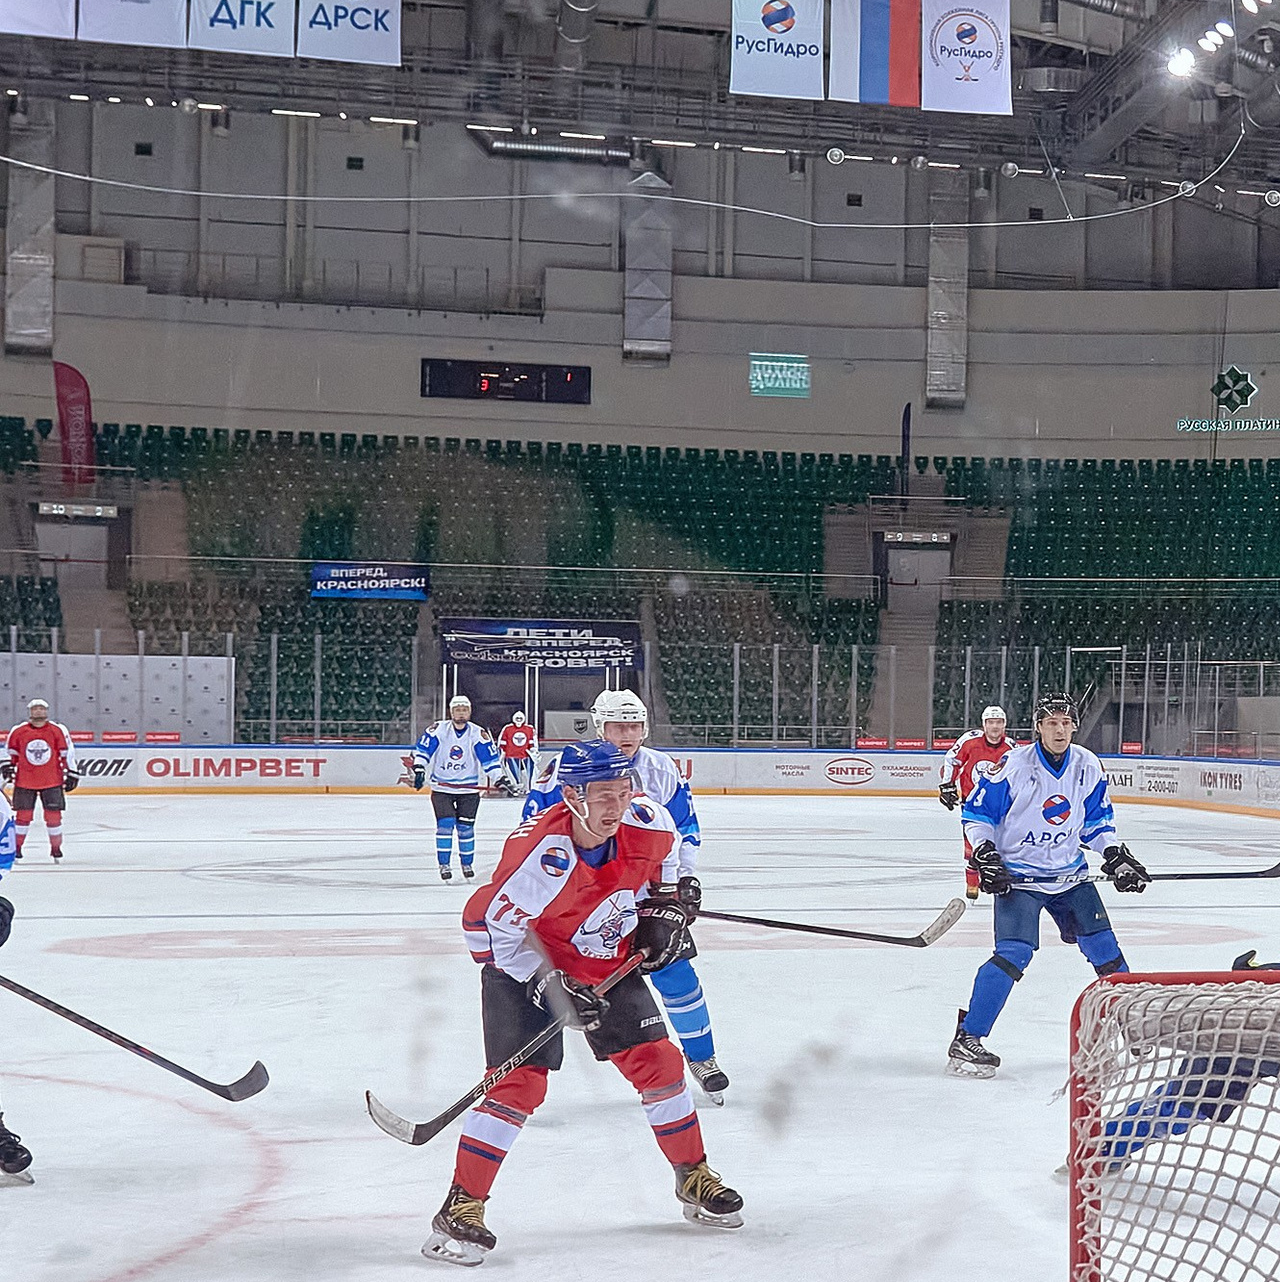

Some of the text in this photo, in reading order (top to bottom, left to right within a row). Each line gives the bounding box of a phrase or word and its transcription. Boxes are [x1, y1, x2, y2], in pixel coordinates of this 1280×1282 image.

[309, 3, 390, 32] ДРСК
[735, 34, 819, 58] РусГидро
[940, 45, 993, 59] РусГидро
[1178, 418, 1231, 432] РУССКАЯ
[330, 567, 388, 578] ВПЕРЕД,
[316, 577, 426, 590] КРАСНОЯРСК!
[503, 648, 635, 658] КРАСНОЯРСК
[528, 657, 634, 668] ЗОВЕТ!
[146, 758, 328, 778] OLIMPBET
[827, 766, 873, 777] SINTEC
[1200, 771, 1217, 789] IKON
[1219, 772, 1243, 791] TYRES
